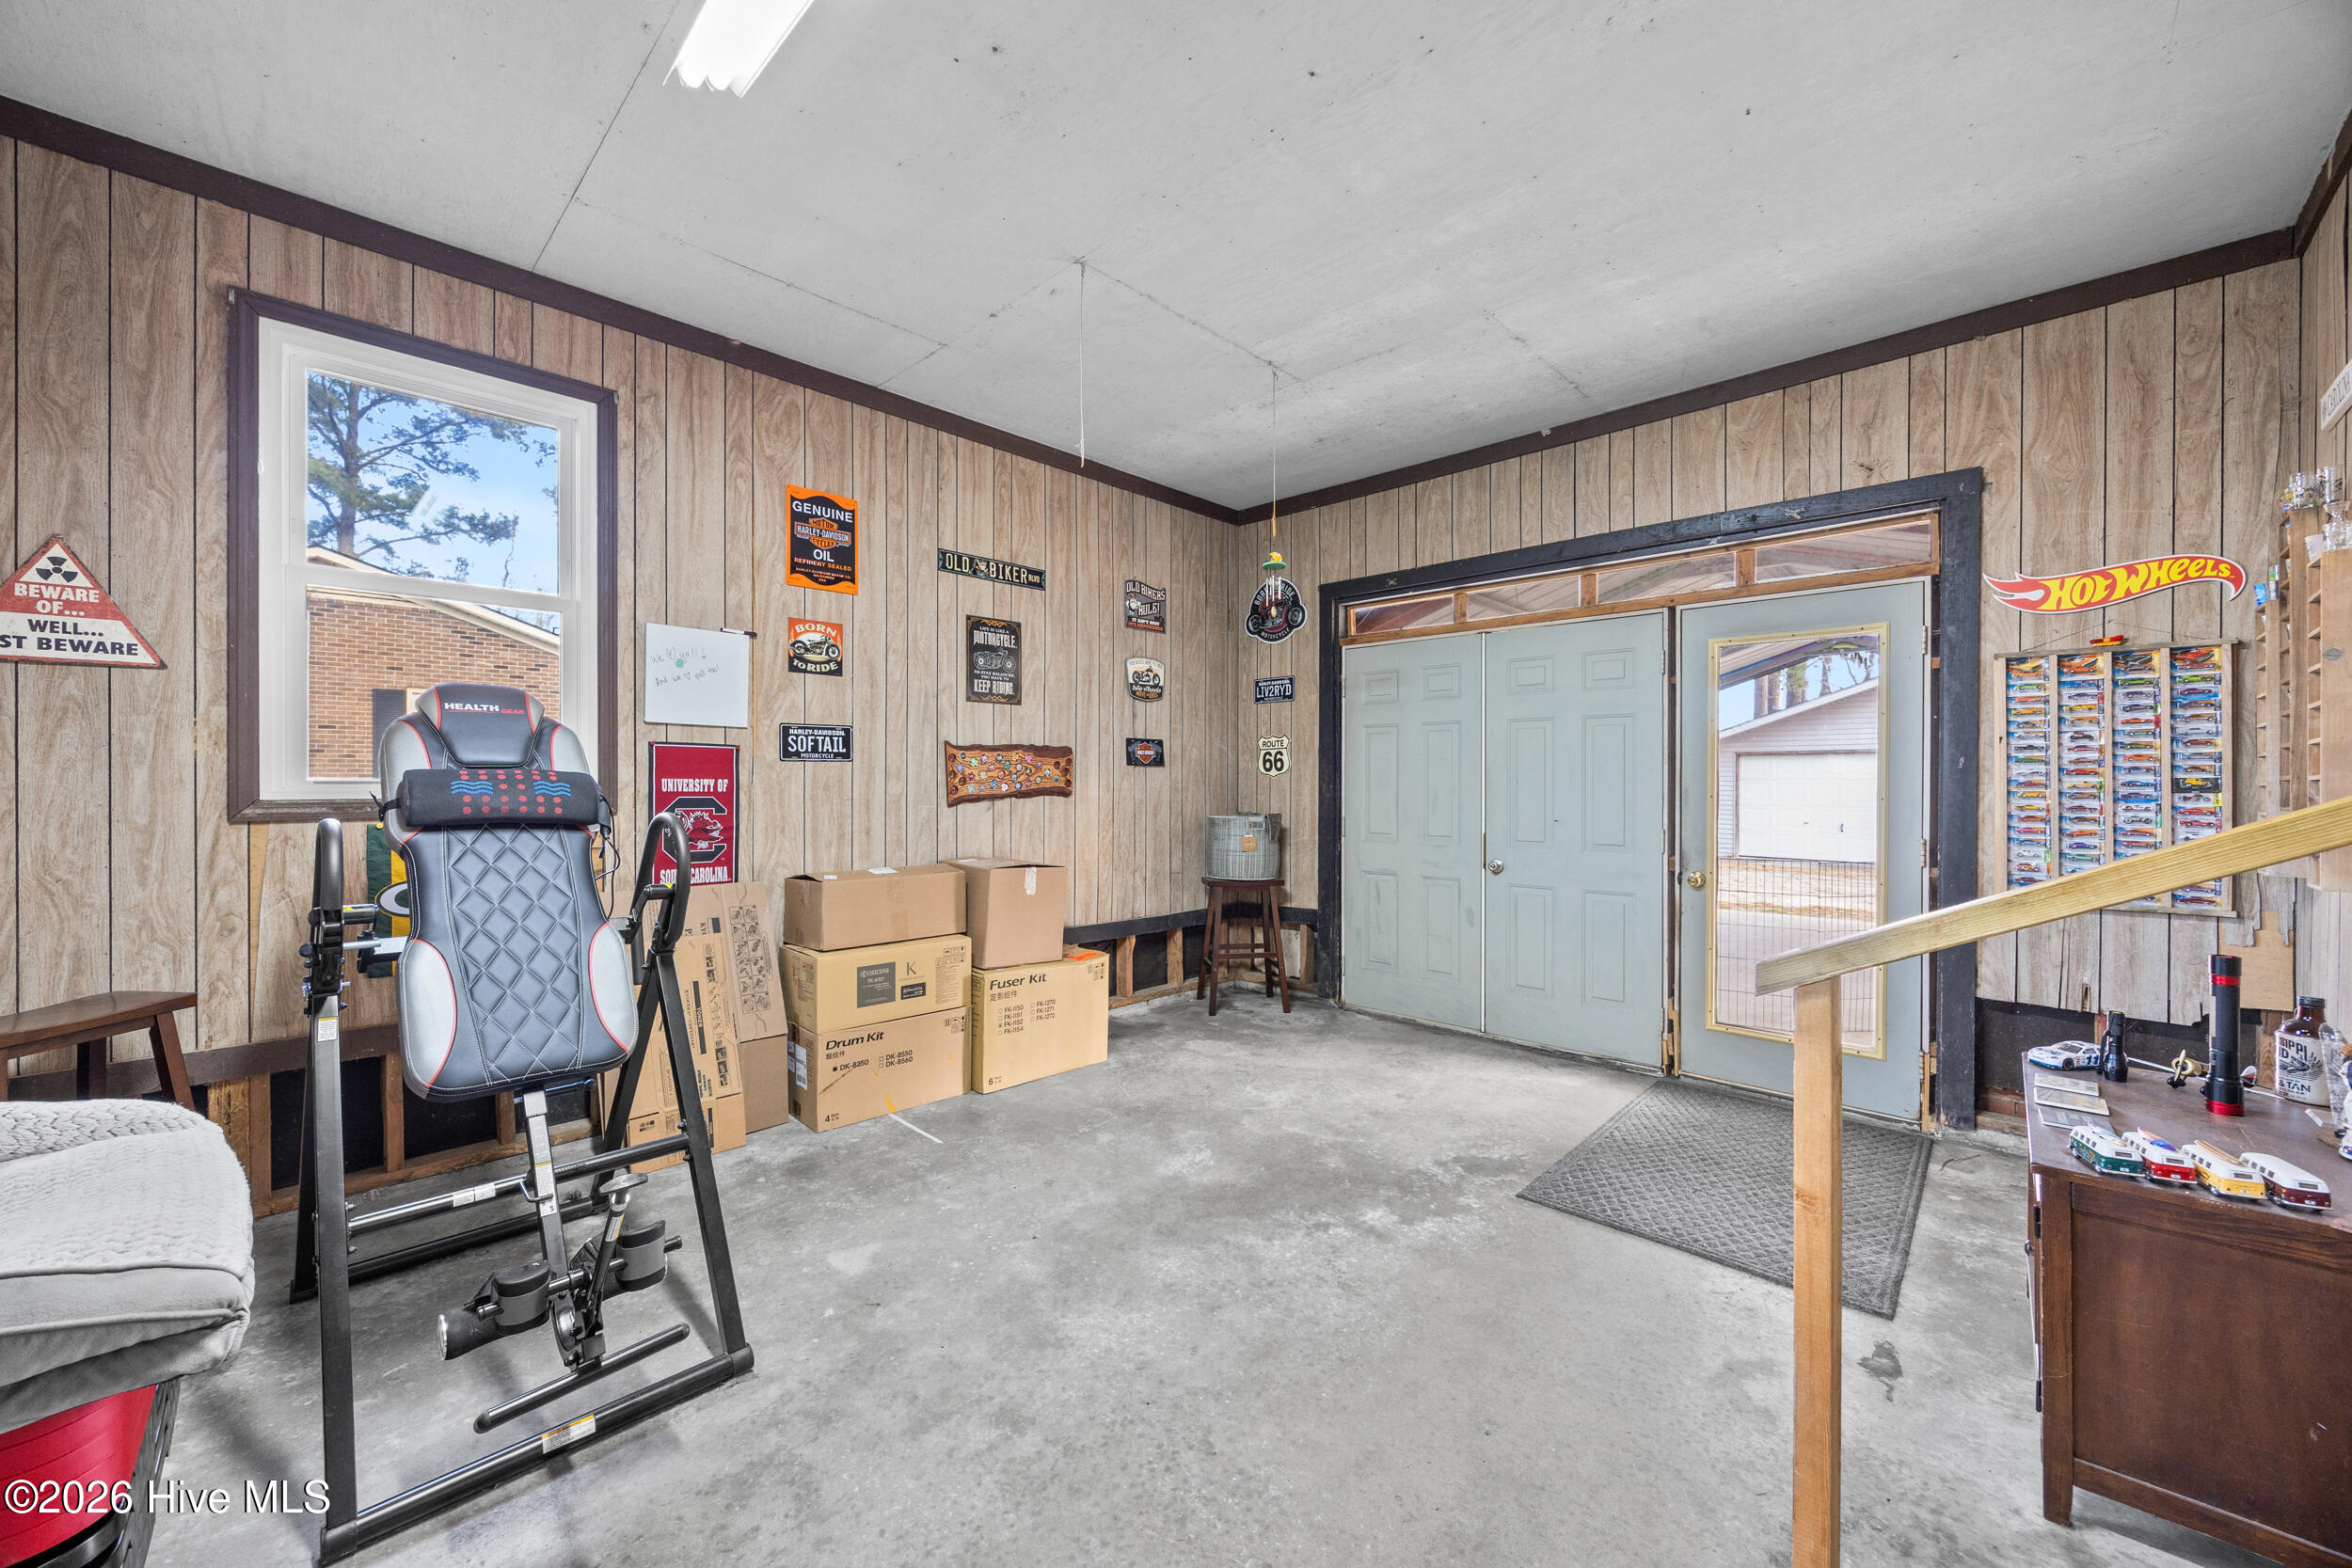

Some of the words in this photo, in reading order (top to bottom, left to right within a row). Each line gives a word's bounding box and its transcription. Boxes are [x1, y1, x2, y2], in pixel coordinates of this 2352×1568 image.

[792, 500, 853, 523] GENUINE
[812, 518, 834, 529] MOTOR
[797, 524, 850, 543] HARLEY-DAVIDSON
[813, 548, 834, 562] OIL
[794, 557, 826, 567] REFINERY
[828, 562, 852, 572] SEALED
[946, 553, 970, 573] OLD
[989, 562, 1028, 585] BIKER
[1027, 574, 1041, 584] BLVD
[14, 583, 100, 603] BEWARE
[1126, 581, 1140, 594] OLD
[1140, 584, 1166, 601] BIKERS
[36, 599, 85, 617] OF...
[27, 619, 104, 637] WELL...
[794, 623, 837, 638] BORN
[37, 637, 138, 657] BEWARE
[793, 658, 806, 670] TO
[806, 661, 839, 673] RIDE
[974, 679, 991, 692] KEEP
[1256, 684, 1292, 698] LIV2RYD
[444, 702, 500, 712] HEALTH
[788, 728, 846, 736] HARLEY-DAVIDSON
[787, 735, 847, 753] SOFTAIL
[1262, 739, 1284, 749] ROUTE
[1263, 751, 1285, 773] 66
[660, 778, 715, 792] UNIVERSITY
[717, 779, 729, 792] OF
[691, 866, 728, 884] CAROLINA
[866, 967, 889, 977] KYOCERA
[906, 961, 916, 976] K
[990, 977, 1025, 990] Fuser
[1029, 973, 1047, 984] Kit
[990, 990, 1017, 1002] 定影组件
[825, 1037, 865, 1051] Drum
[866, 1031, 884, 1042] Kit
[885, 1050, 914, 1061] DK-8550
[885, 1056, 914, 1068] DK-8560
[2086, 1054, 2099, 1065] 11
[839, 1059, 869, 1070] DK-8350
[2286, 1081, 2311, 1092] TAN
